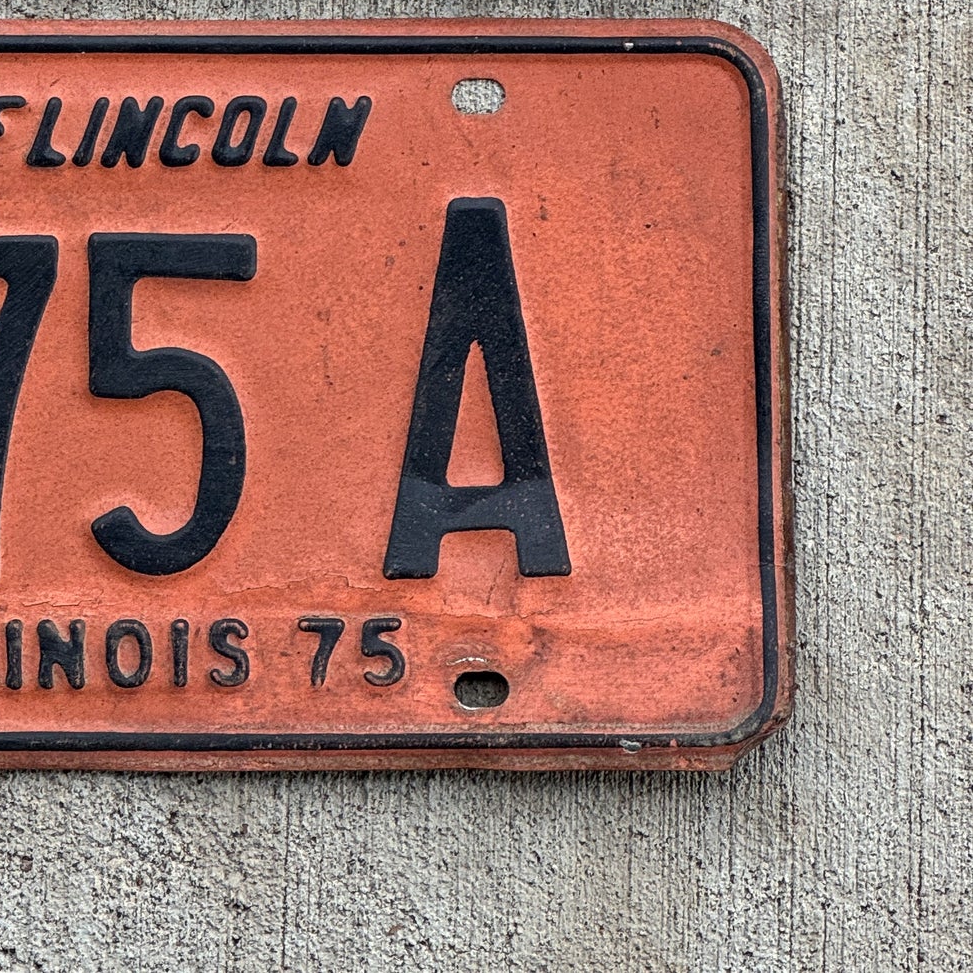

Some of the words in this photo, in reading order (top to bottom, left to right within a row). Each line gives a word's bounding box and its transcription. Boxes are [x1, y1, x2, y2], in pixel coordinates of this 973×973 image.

[25, 95, 373, 169] LINCOLN
[382, 196, 572, 581] A
[297, 617, 406, 687] 75
